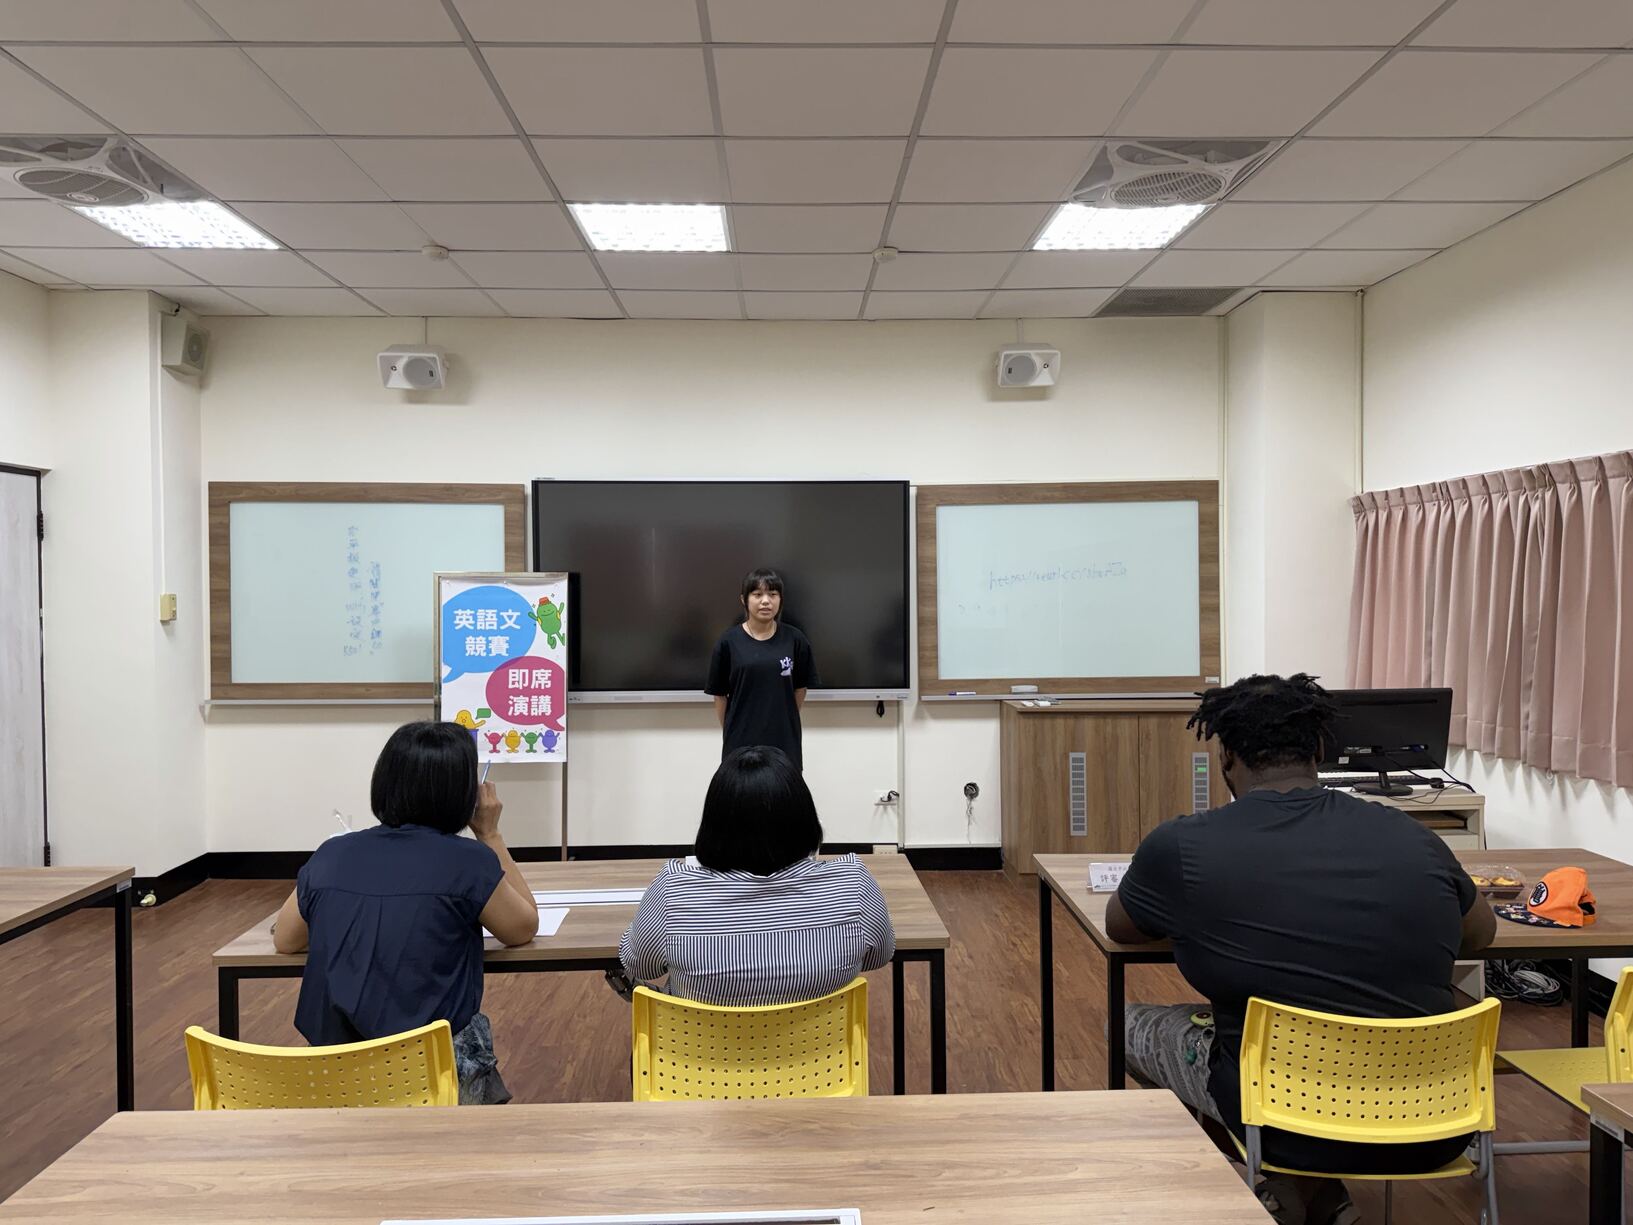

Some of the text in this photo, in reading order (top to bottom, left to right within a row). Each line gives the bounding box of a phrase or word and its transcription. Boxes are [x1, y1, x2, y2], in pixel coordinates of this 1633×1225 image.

[453, 608, 521, 630] 英語文
[464, 635, 510, 657] 競賽
[507, 668, 552, 690] 即席
[507, 695, 552, 717] 演講
